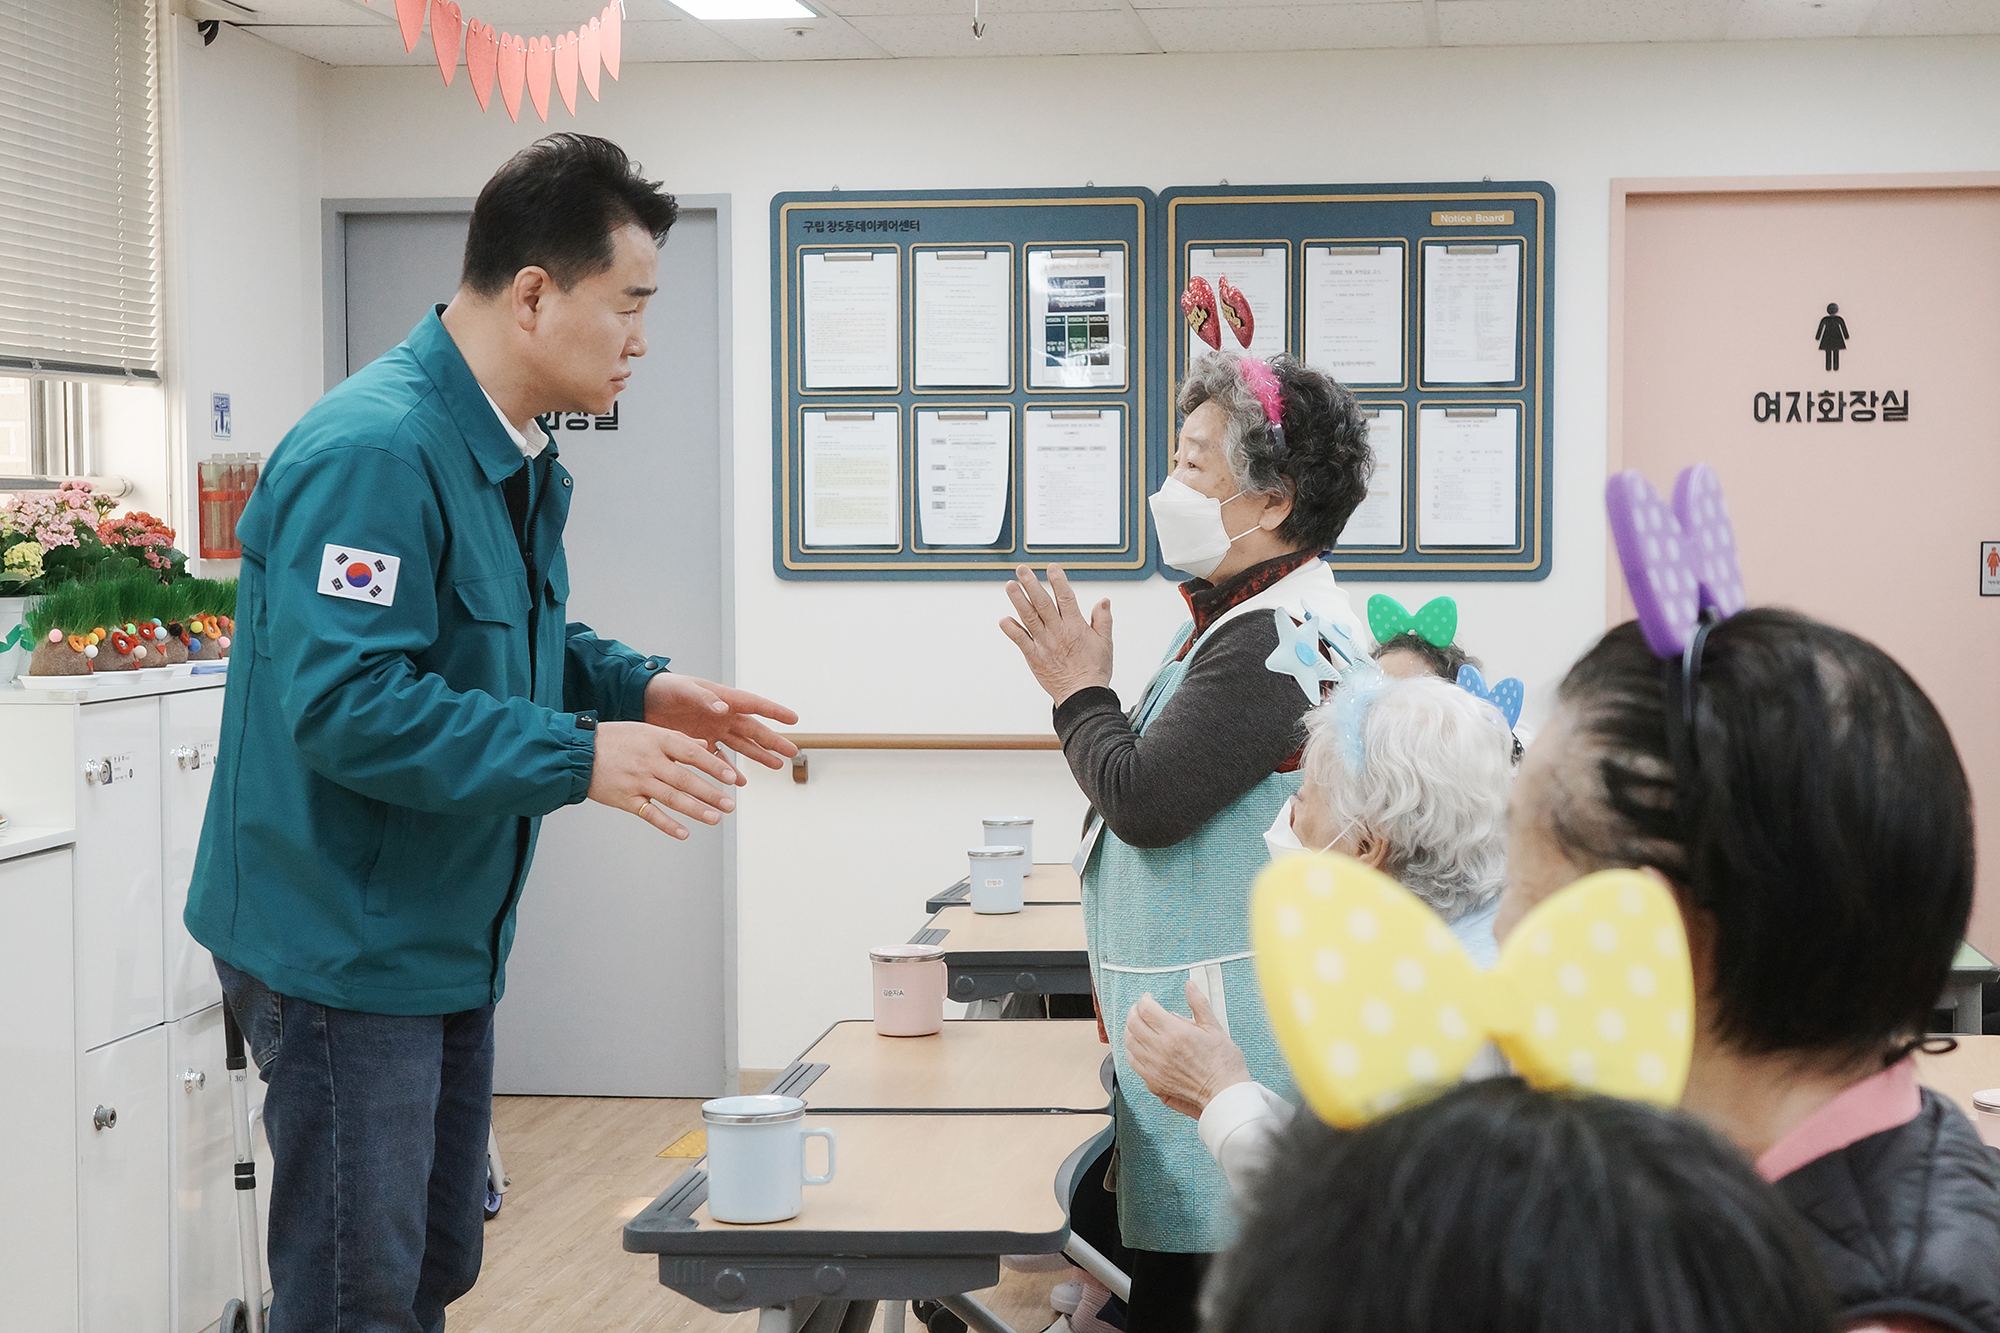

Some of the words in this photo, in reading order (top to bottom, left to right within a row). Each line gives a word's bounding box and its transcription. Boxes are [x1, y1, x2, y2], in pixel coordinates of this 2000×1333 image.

[1440, 213, 1473, 223] Notice
[1475, 213, 1505, 222] Board
[803, 220, 825, 233] 구립
[827, 219, 920, 233] 창5동데이케어센터
[1754, 390, 1909, 423] 여자화장실
